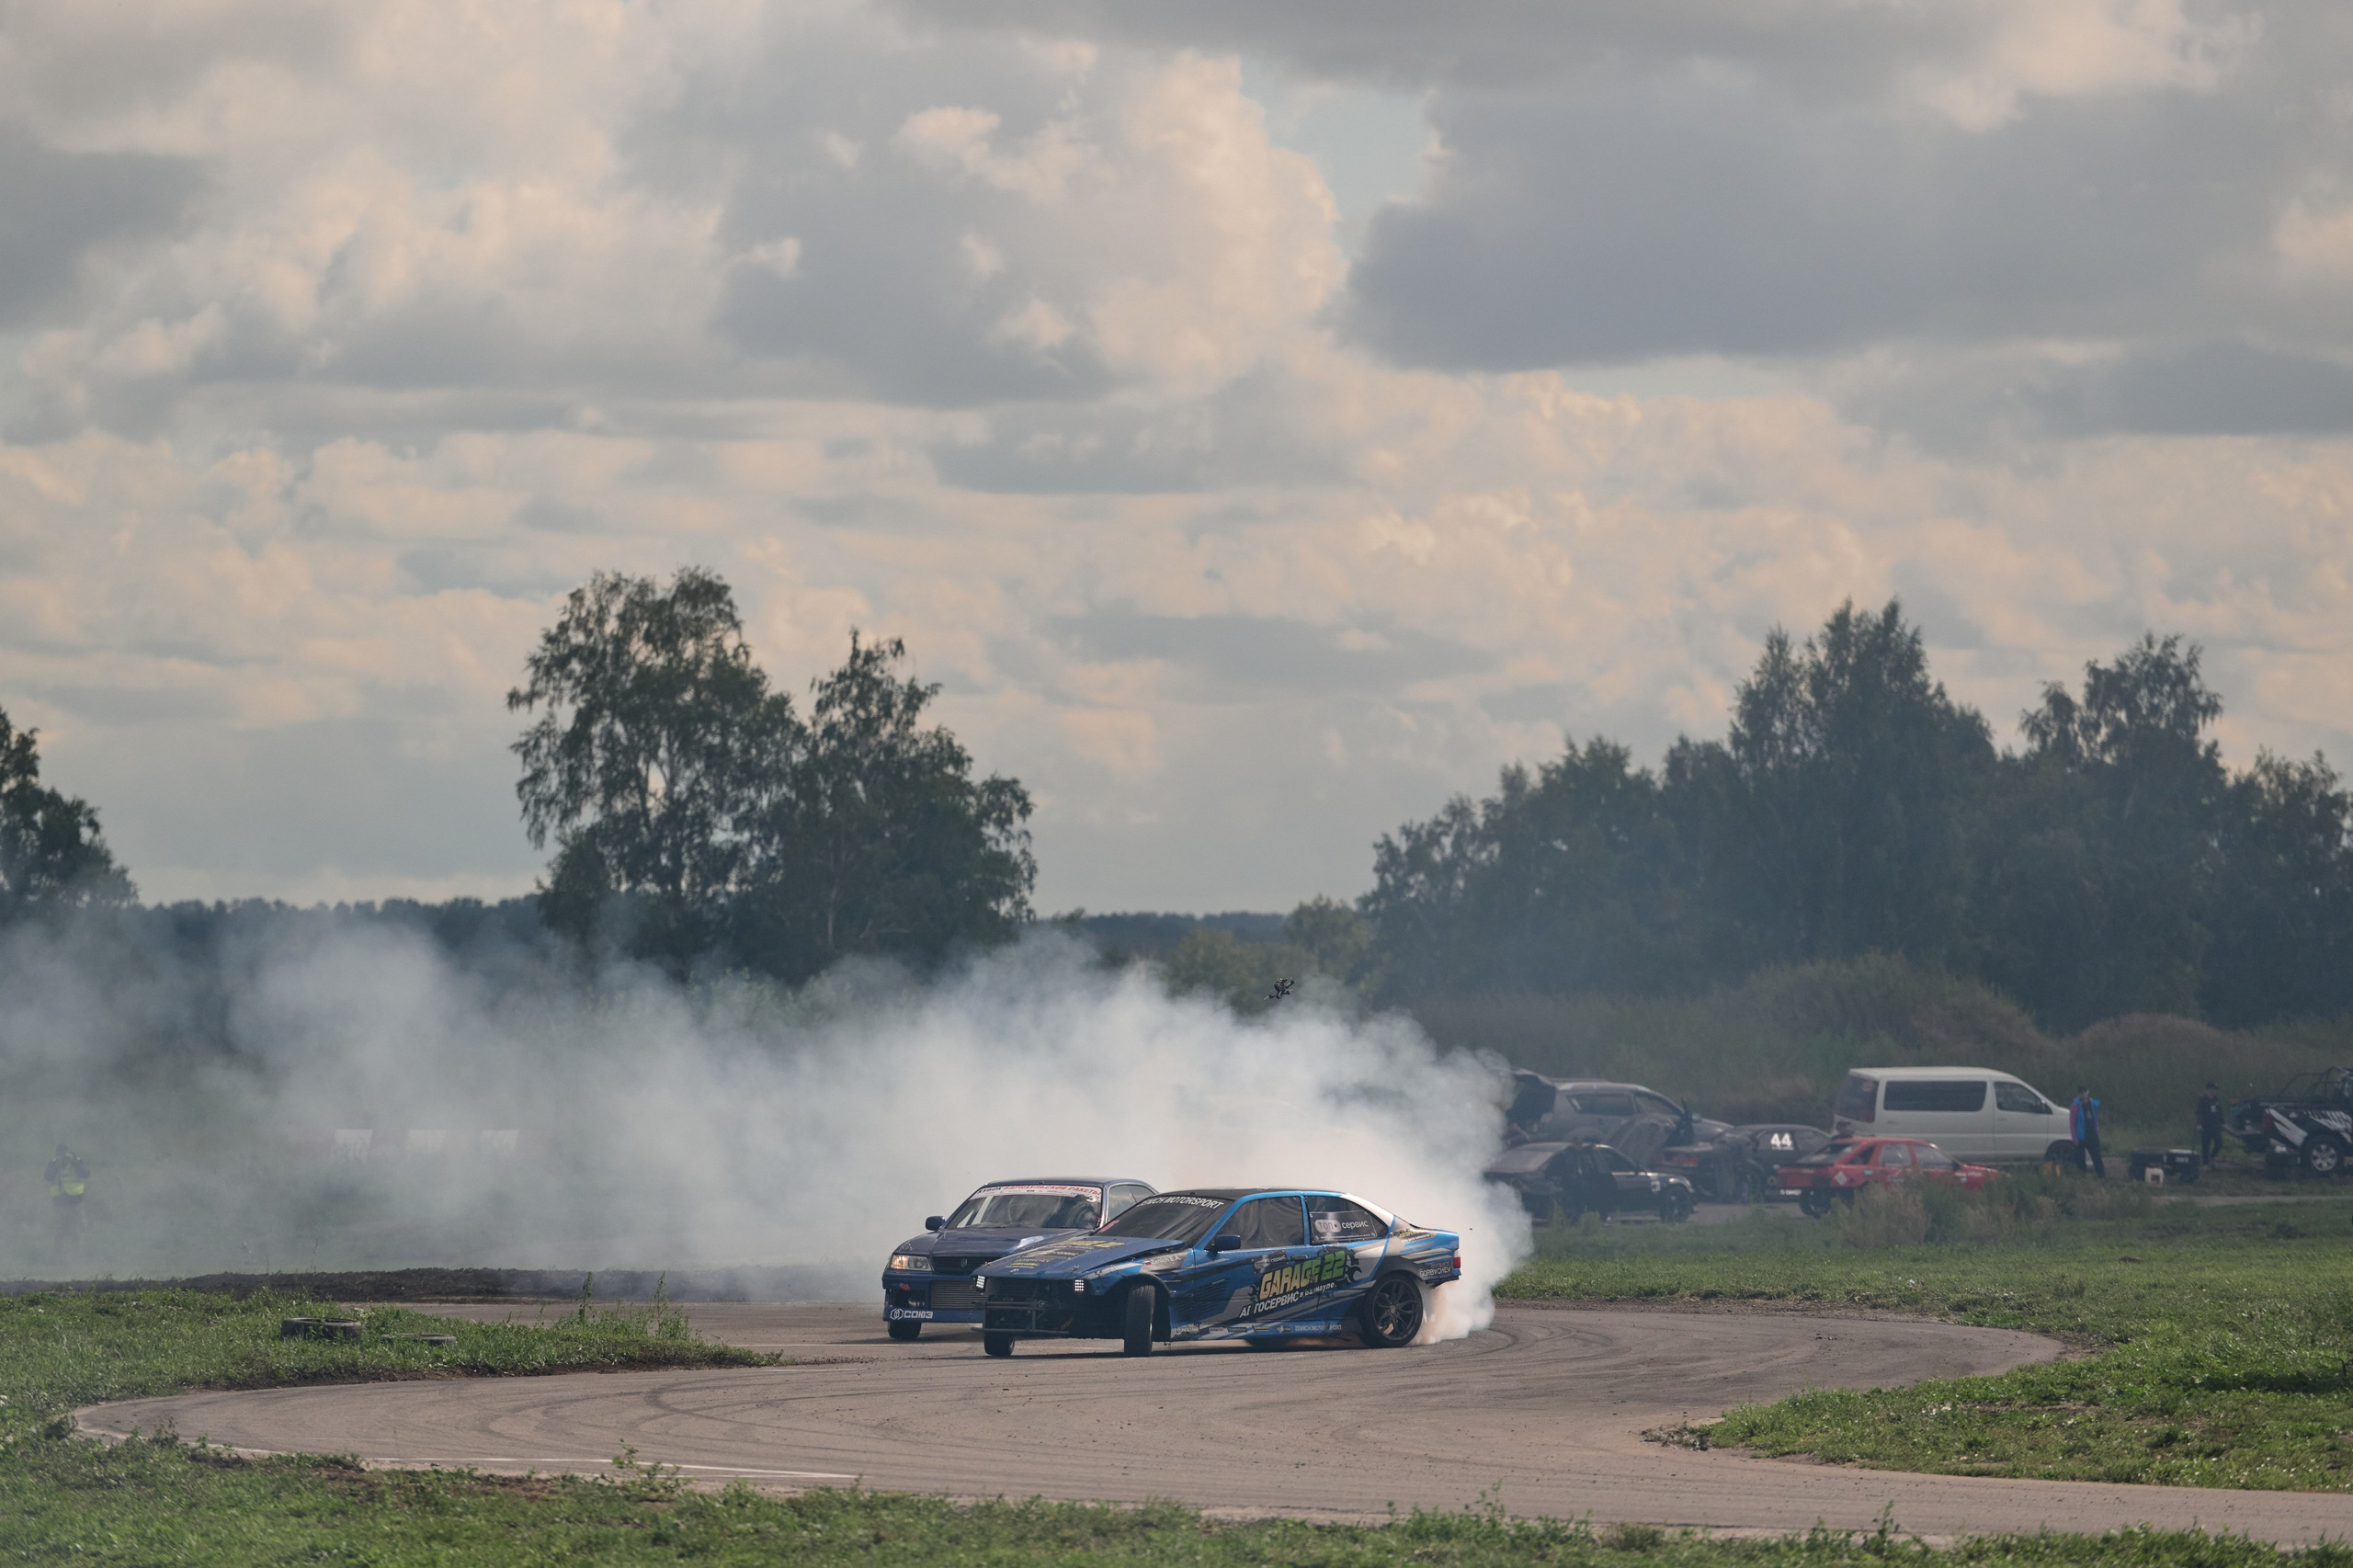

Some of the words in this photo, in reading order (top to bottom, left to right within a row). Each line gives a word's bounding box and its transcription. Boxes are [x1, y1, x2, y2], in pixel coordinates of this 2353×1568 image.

[1770, 1132, 1792, 1147] 44
[1163, 1196, 1224, 1209] MOTORSPORT
[1341, 1221, 1369, 1230] сервис
[1259, 1256, 1322, 1301] GARAGE
[1321, 1250, 1347, 1281] 22
[904, 1310, 934, 1319] СОЮЗ
